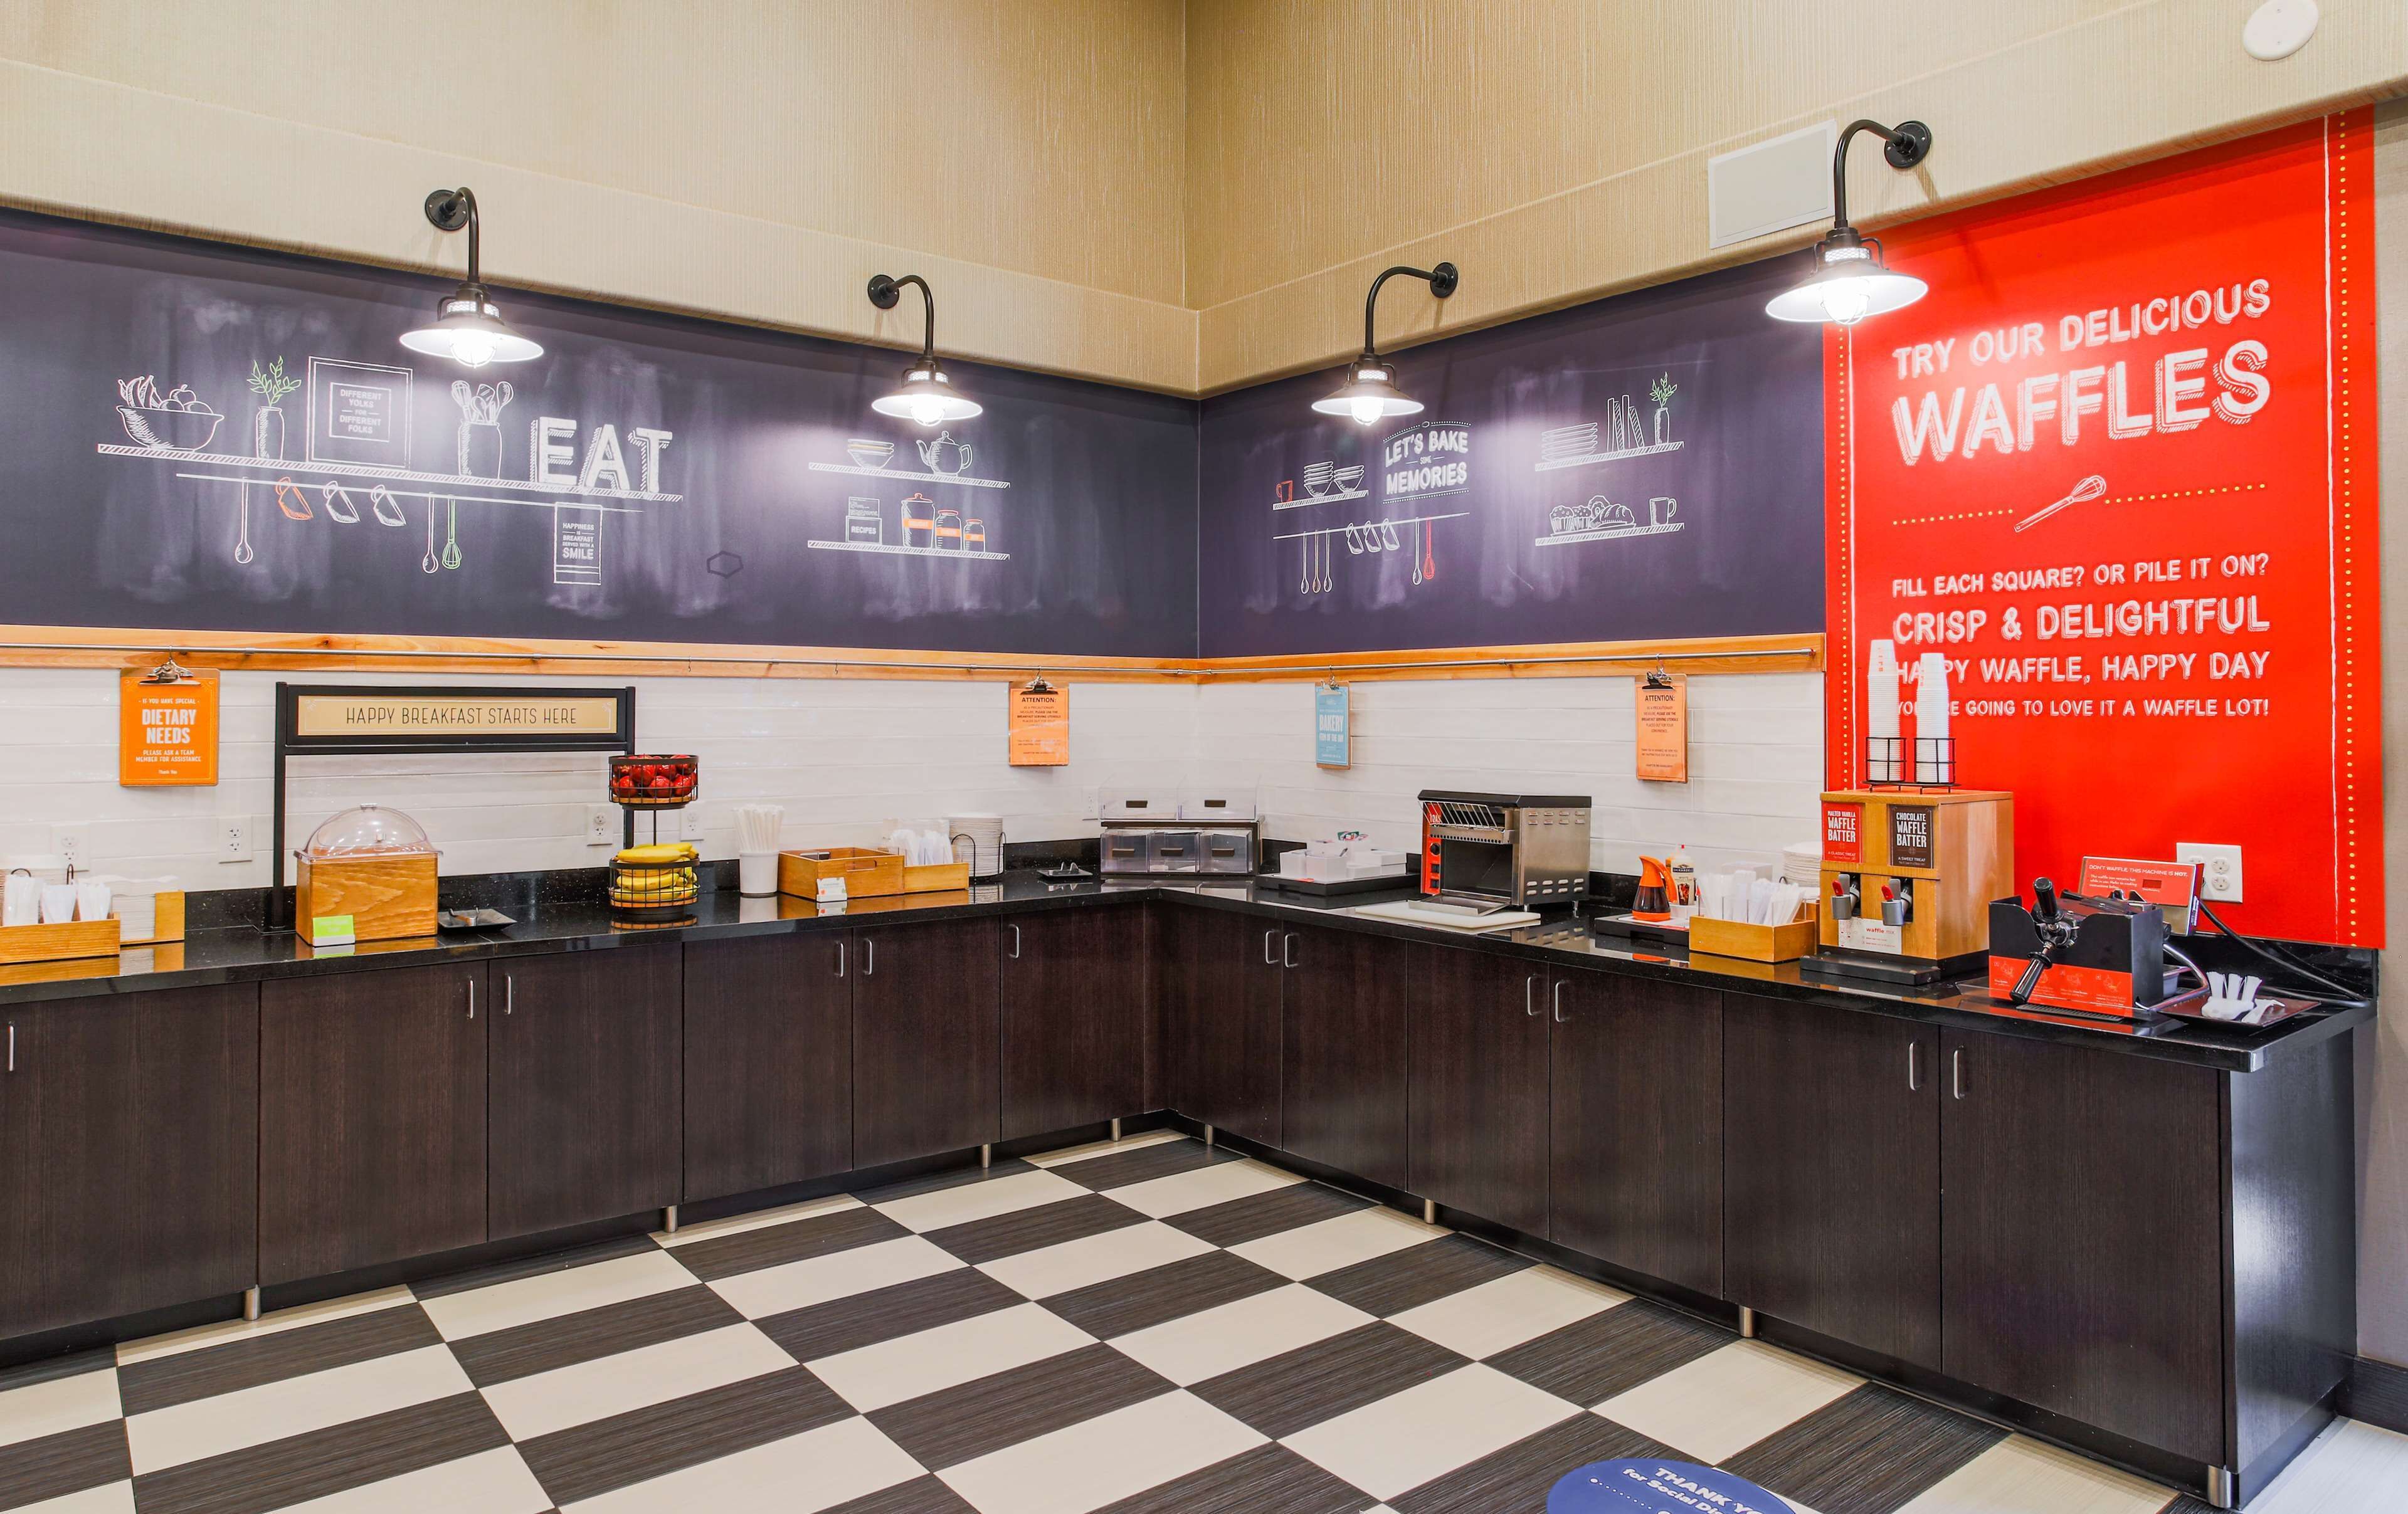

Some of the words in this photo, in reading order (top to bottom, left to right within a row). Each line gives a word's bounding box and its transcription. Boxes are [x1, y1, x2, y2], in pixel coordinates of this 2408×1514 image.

[1892, 338, 1955, 379] TRY
[1969, 322, 2046, 366] OUR
[2059, 278, 2270, 352] DELICIOUS
[341, 389, 381, 400] DIFFERENT
[349, 398, 374, 407] YOLKS
[1892, 340, 2271, 466] WAFFLES
[340, 414, 381, 426] DIFFERENT
[348, 424, 372, 434] FOLKS
[529, 416, 673, 494] EAT
[1385, 433, 1423, 468] LET'S
[1428, 430, 1469, 453] BAKE
[1386, 461, 1467, 495] MEMORIES
[562, 522, 594, 530] HAPPINESS
[851, 526, 877, 535] RECIPES
[562, 547, 594, 560] SMILE
[1893, 579, 1927, 598] FILL
[1934, 573, 1984, 596] EACH
[1991, 566, 2085, 591] SQUARE?
[2093, 564, 2126, 584] OR
[2134, 559, 2182, 582] PILE
[2190, 557, 2211, 579] IT
[2221, 552, 2270, 579] ON?
[1893, 609, 1987, 644] CRISP
[2001, 606, 2022, 640] &
[2036, 595, 2270, 640] DELIGHTFUL
[1896, 658, 1970, 684] HAPY
[1980, 656, 2091, 685] WAFFLE,
[2103, 653, 2197, 681] HAPPY
[2209, 651, 2270, 680] DAY
[346, 707, 395, 724] HAPPY
[402, 707, 482, 724] BREAKFAST
[488, 708, 537, 724] STARTS
[544, 708, 577, 724] HERE
[1966, 699, 2015, 716] GOING
[2023, 699, 2043, 716] TO
[2050, 699, 2093, 716] LOVE
[2100, 700, 2116, 716] IT
[2123, 699, 2135, 716] A
[2144, 698, 2218, 716] WAFFLE
[2225, 698, 2270, 716] LOT!
[142, 708, 196, 725] DIETARY
[1319, 714, 1344, 732] BAKERY
[146, 727, 191, 744] NEEDS
[1827, 816, 1856, 830] WAFFLE
[1896, 812, 1926, 822] CHOCOLATE
[1827, 829, 1856, 843] BATTER
[1896, 821, 1927, 834] WAFFLE
[1896, 833, 1927, 848] BATTER
[1622, 1468, 1648, 1481] for
[1646, 1480, 1698, 1505] Social
[1655, 1467, 1733, 1506] THANK
